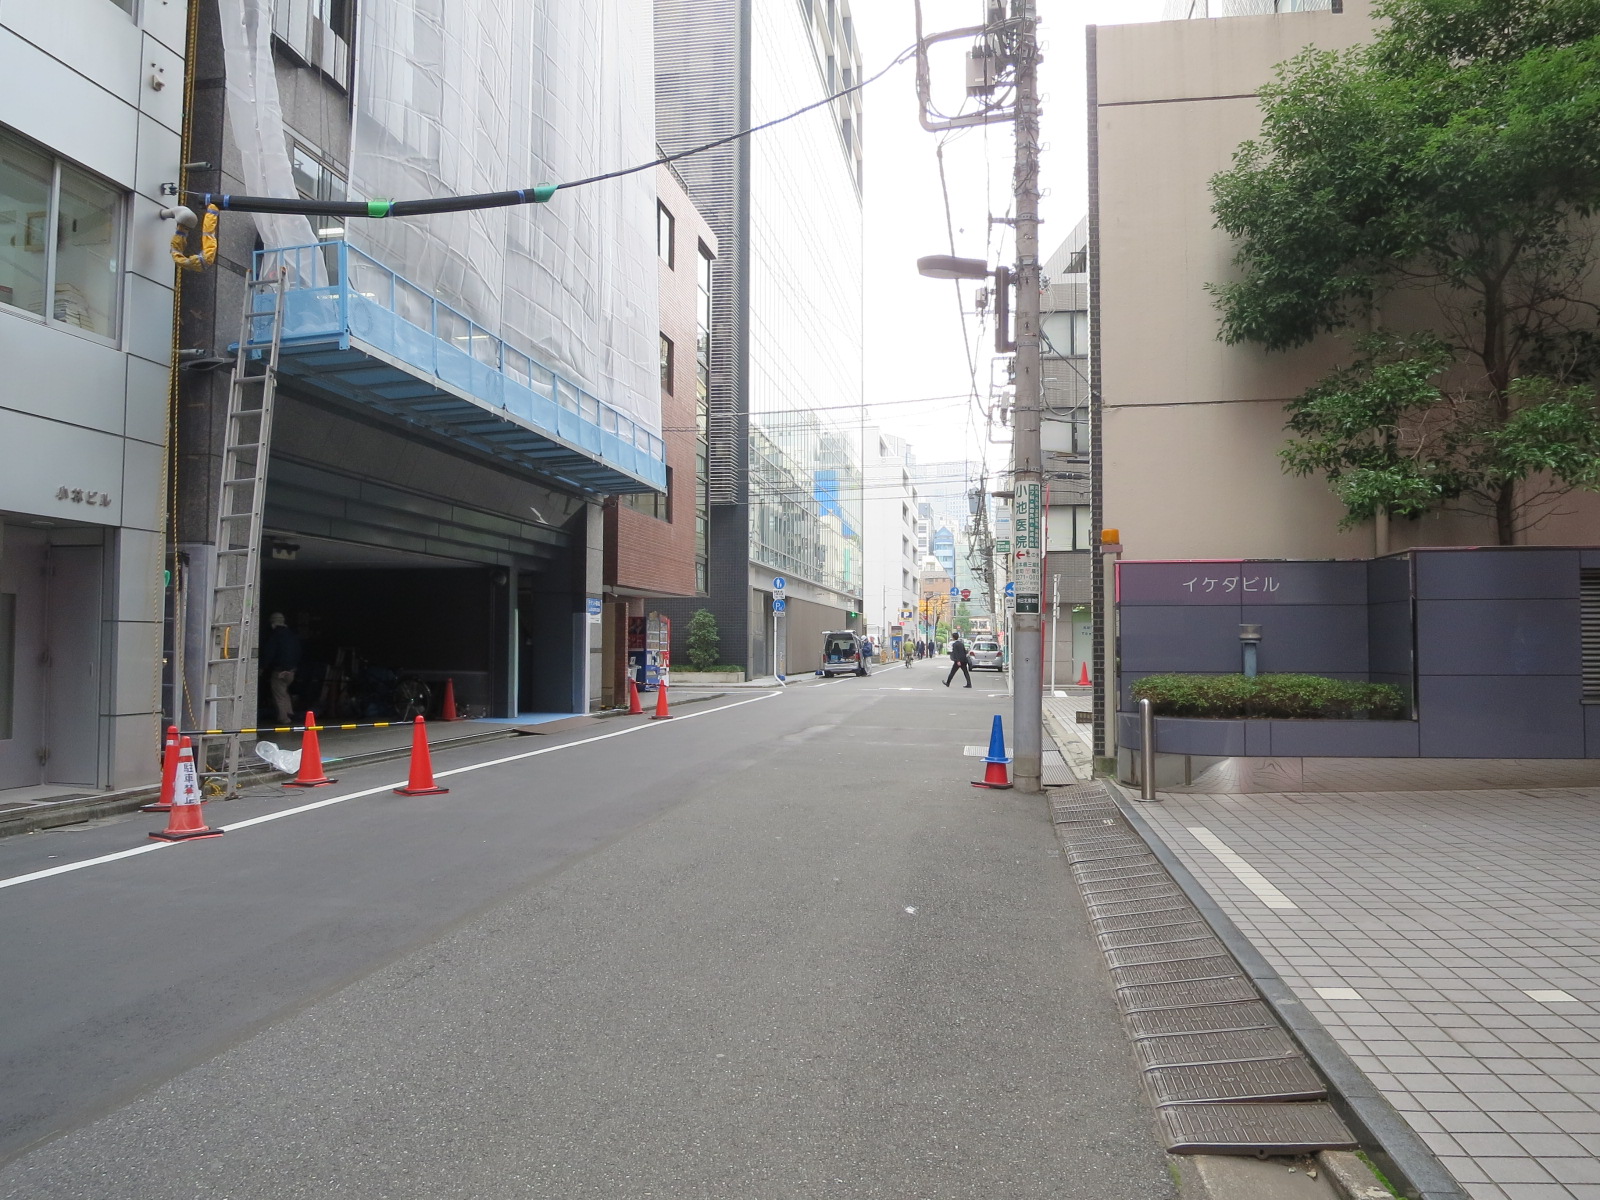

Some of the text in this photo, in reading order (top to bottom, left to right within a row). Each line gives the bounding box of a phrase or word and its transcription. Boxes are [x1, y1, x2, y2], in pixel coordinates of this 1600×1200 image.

[56, 486, 112, 506] 小林ビル
[1016, 484, 1028, 549] 小池医院
[1182, 576, 1280, 593] イケダビル
[184, 763, 194, 804] 駐車禁止
